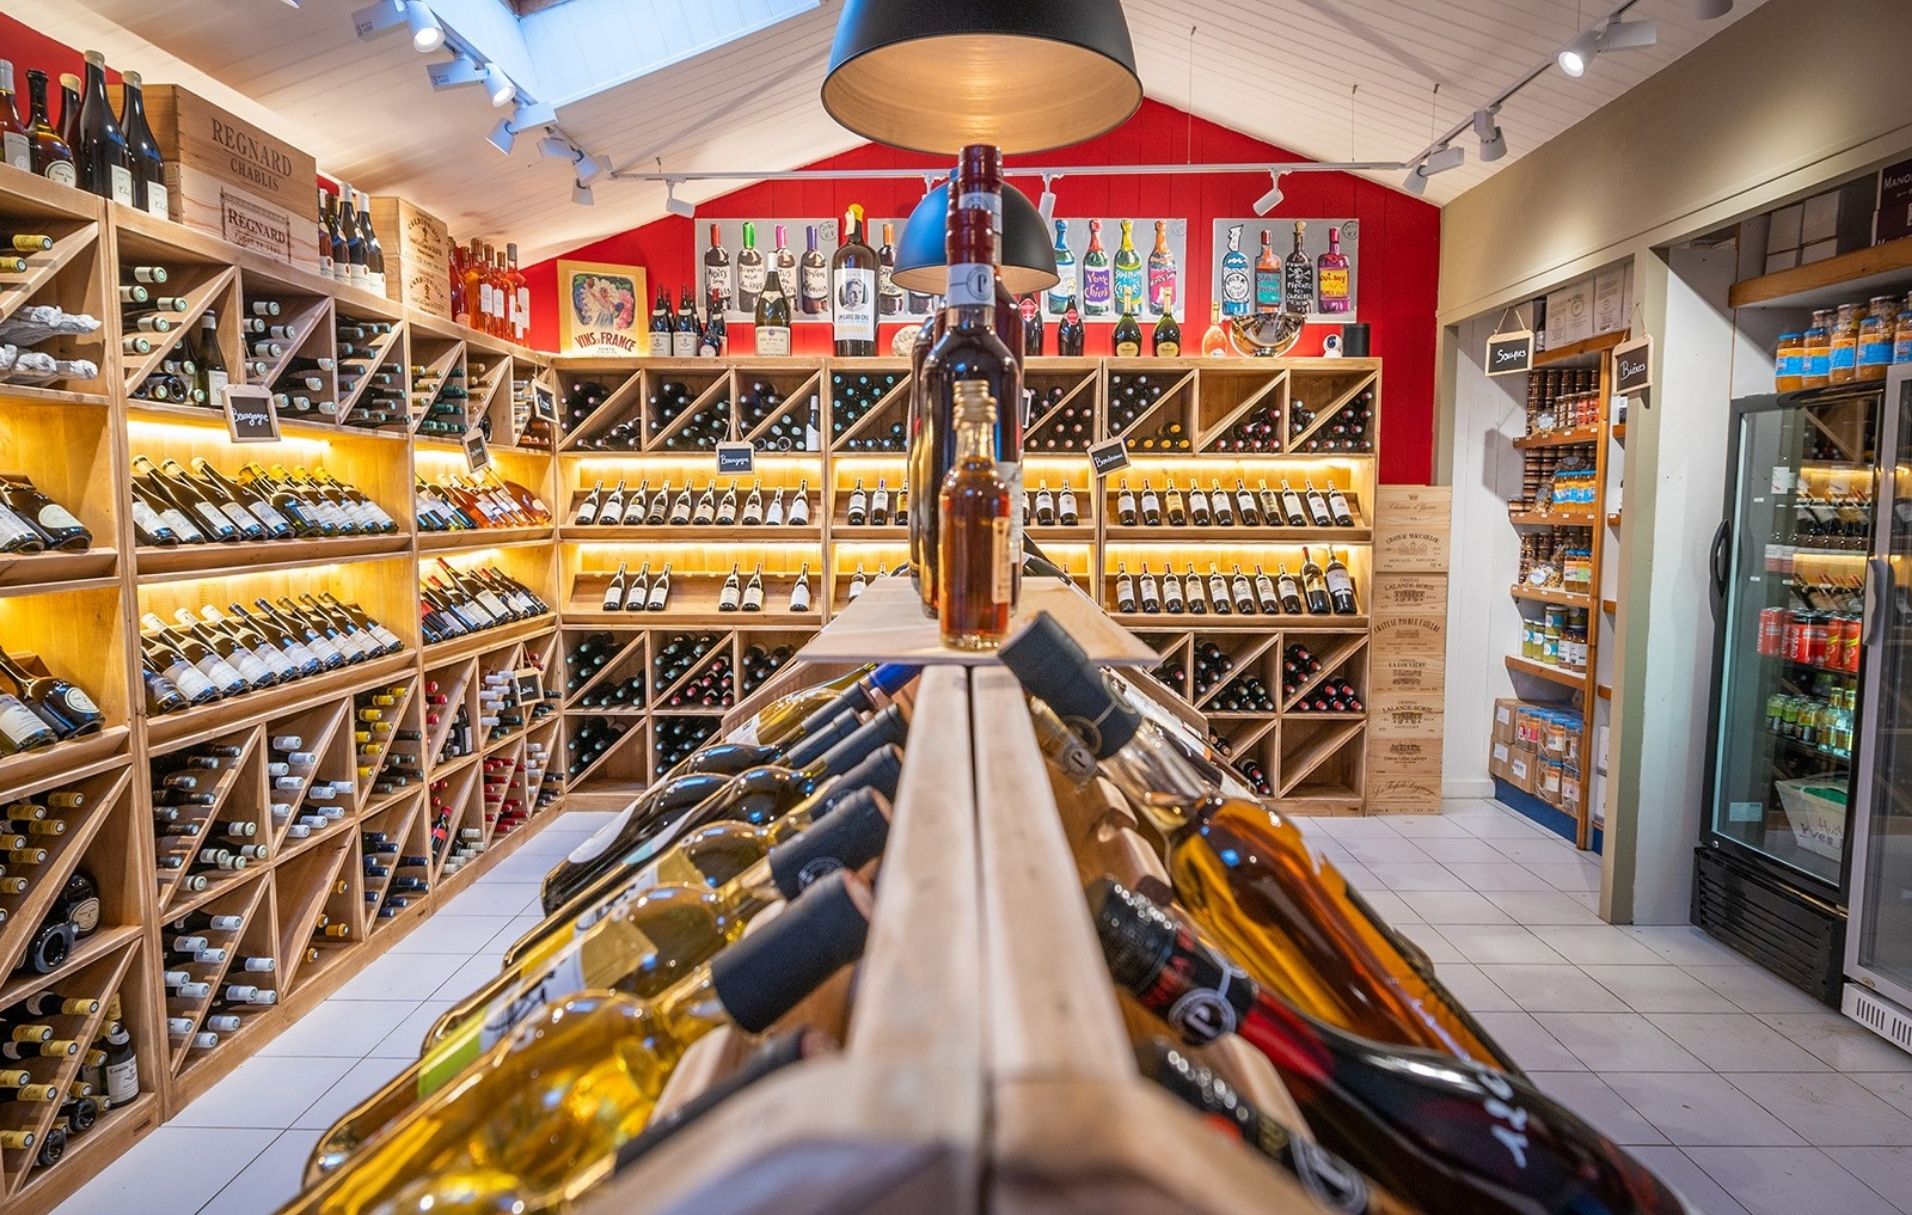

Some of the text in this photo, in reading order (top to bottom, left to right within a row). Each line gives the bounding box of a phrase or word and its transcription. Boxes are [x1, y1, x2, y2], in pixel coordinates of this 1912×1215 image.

[211, 117, 292, 177] REGNARD
[230, 158, 280, 192] CHABLIS
[1884, 174, 1912, 190] MANO
[574, 332, 597, 348] VINS
[601, 332, 637, 352] FRANCE
